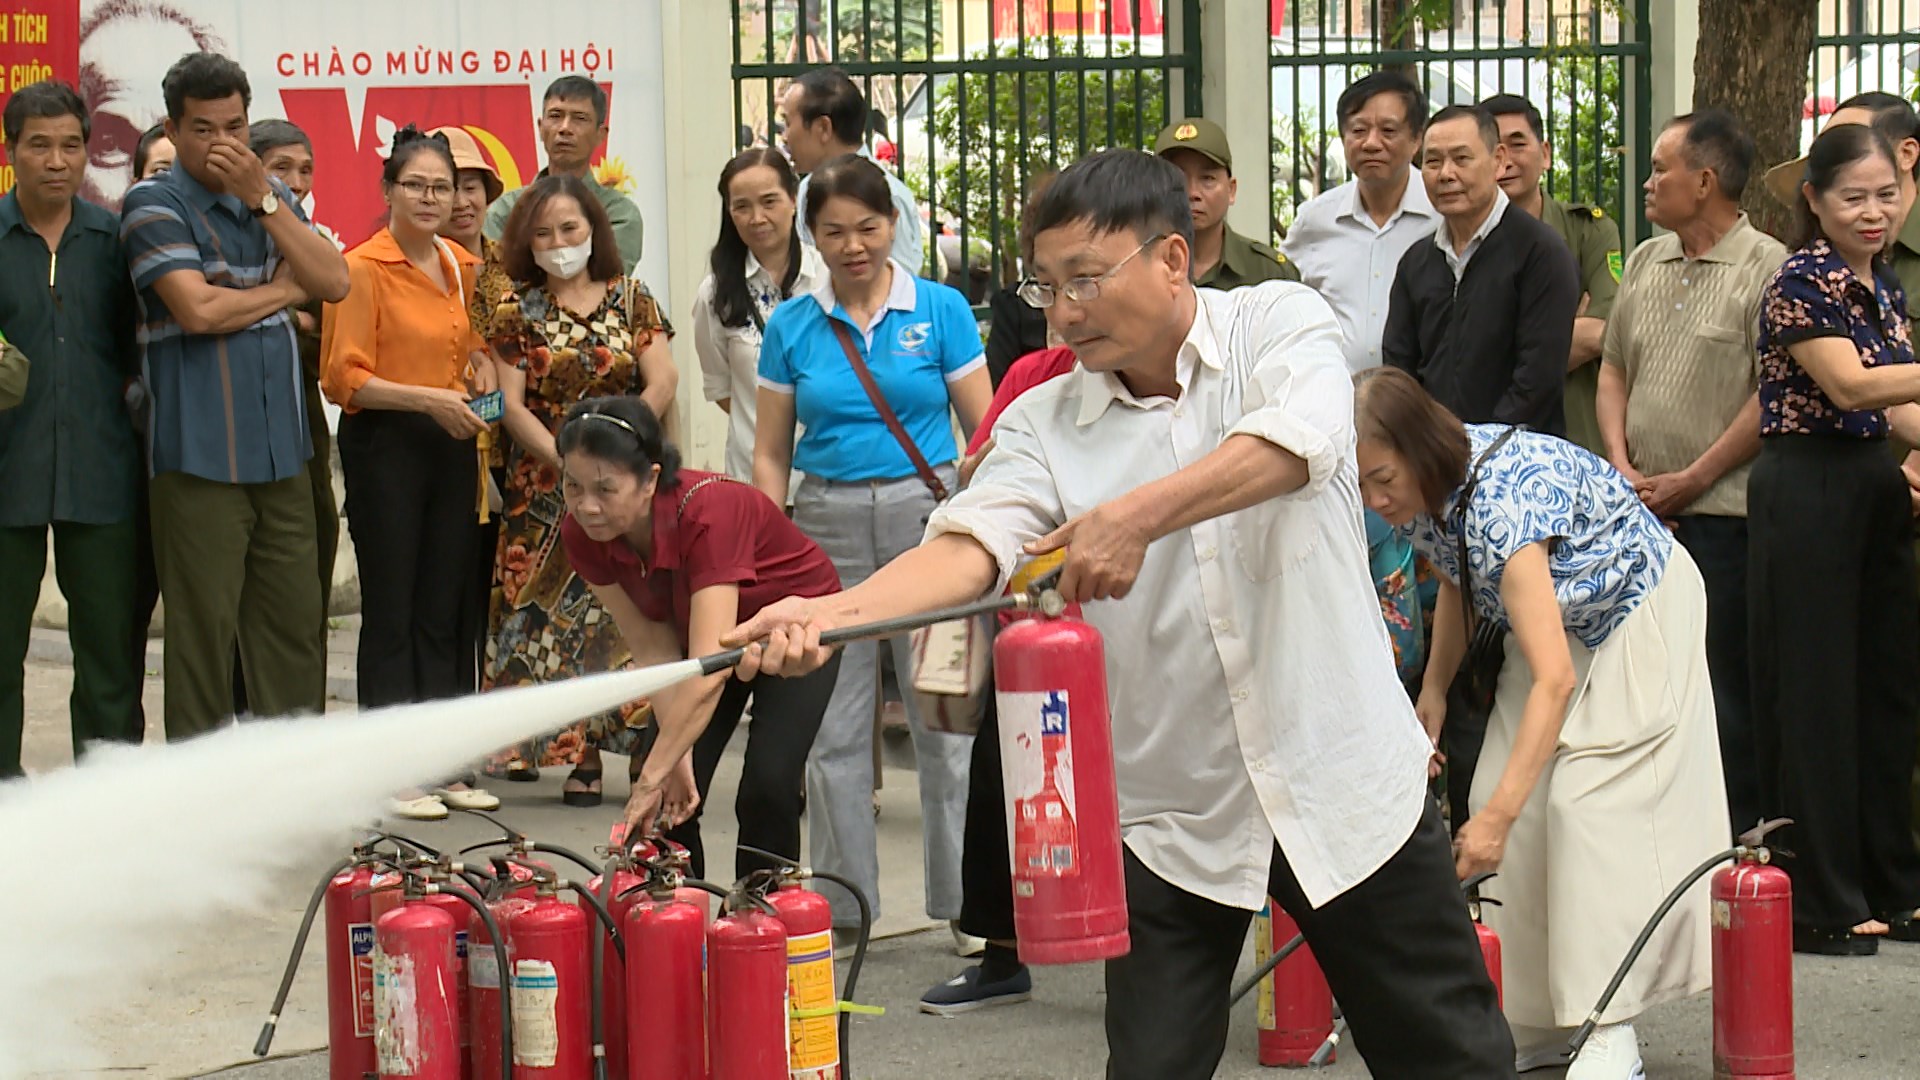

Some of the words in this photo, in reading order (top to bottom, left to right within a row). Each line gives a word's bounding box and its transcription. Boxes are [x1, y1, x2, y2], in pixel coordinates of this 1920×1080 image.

[13, 8, 48, 44] TÍCH
[277, 45, 372, 77] CHÀO
[387, 44, 480, 76] MỪNG
[494, 49, 547, 80] ĐẠI
[561, 42, 613, 79] HỘI
